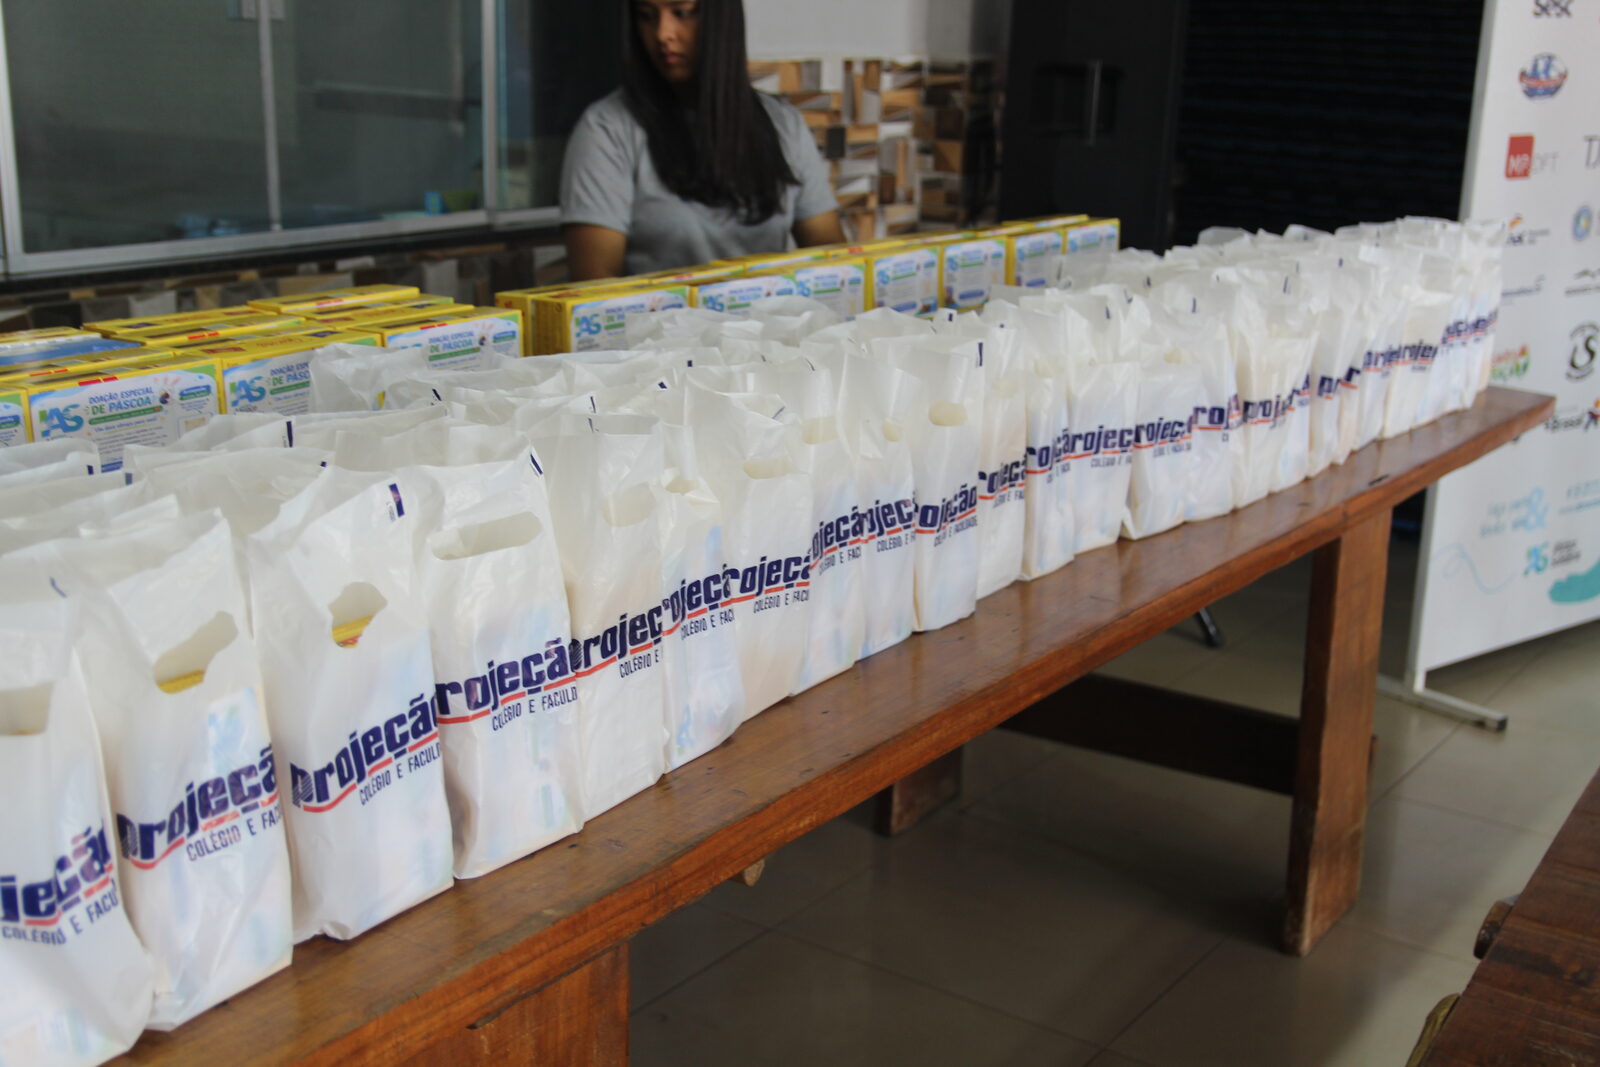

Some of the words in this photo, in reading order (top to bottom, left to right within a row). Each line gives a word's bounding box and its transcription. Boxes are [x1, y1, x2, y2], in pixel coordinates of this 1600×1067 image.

[528, 699, 536, 714] E
[396, 763, 404, 779] E
[186, 824, 242, 862] COLÉGIO
[246, 818, 257, 836] E
[69, 914, 83, 935] E
